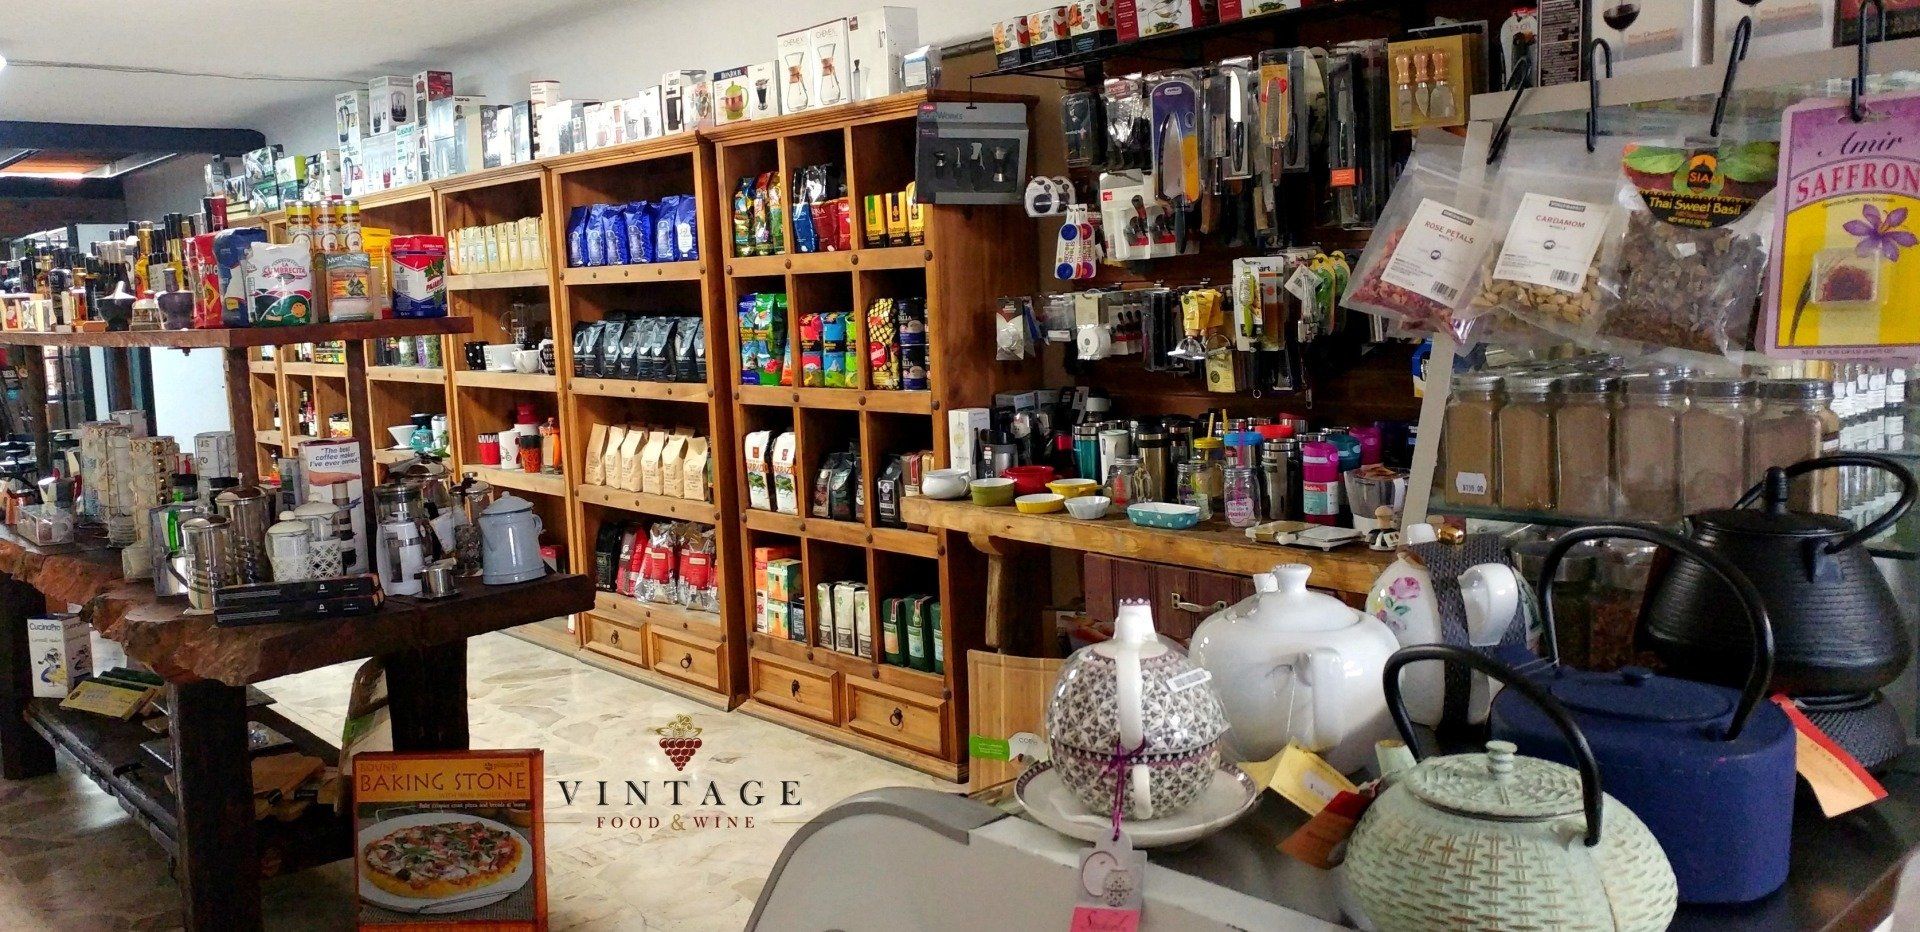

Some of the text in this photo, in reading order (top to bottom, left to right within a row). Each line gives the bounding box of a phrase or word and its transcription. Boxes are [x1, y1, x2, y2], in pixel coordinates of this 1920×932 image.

[1818, 130, 1903, 156] Amir
[1796, 162, 1920, 203] SAFFRON
[1650, 196, 1741, 215] Thai Sweet Basil
[1535, 214, 1586, 228] CARDAMOM
[1424, 220, 1475, 245] ROSE PETALS
[315, 453, 339, 461] coffee
[360, 772, 526, 792] BAKING STONE
